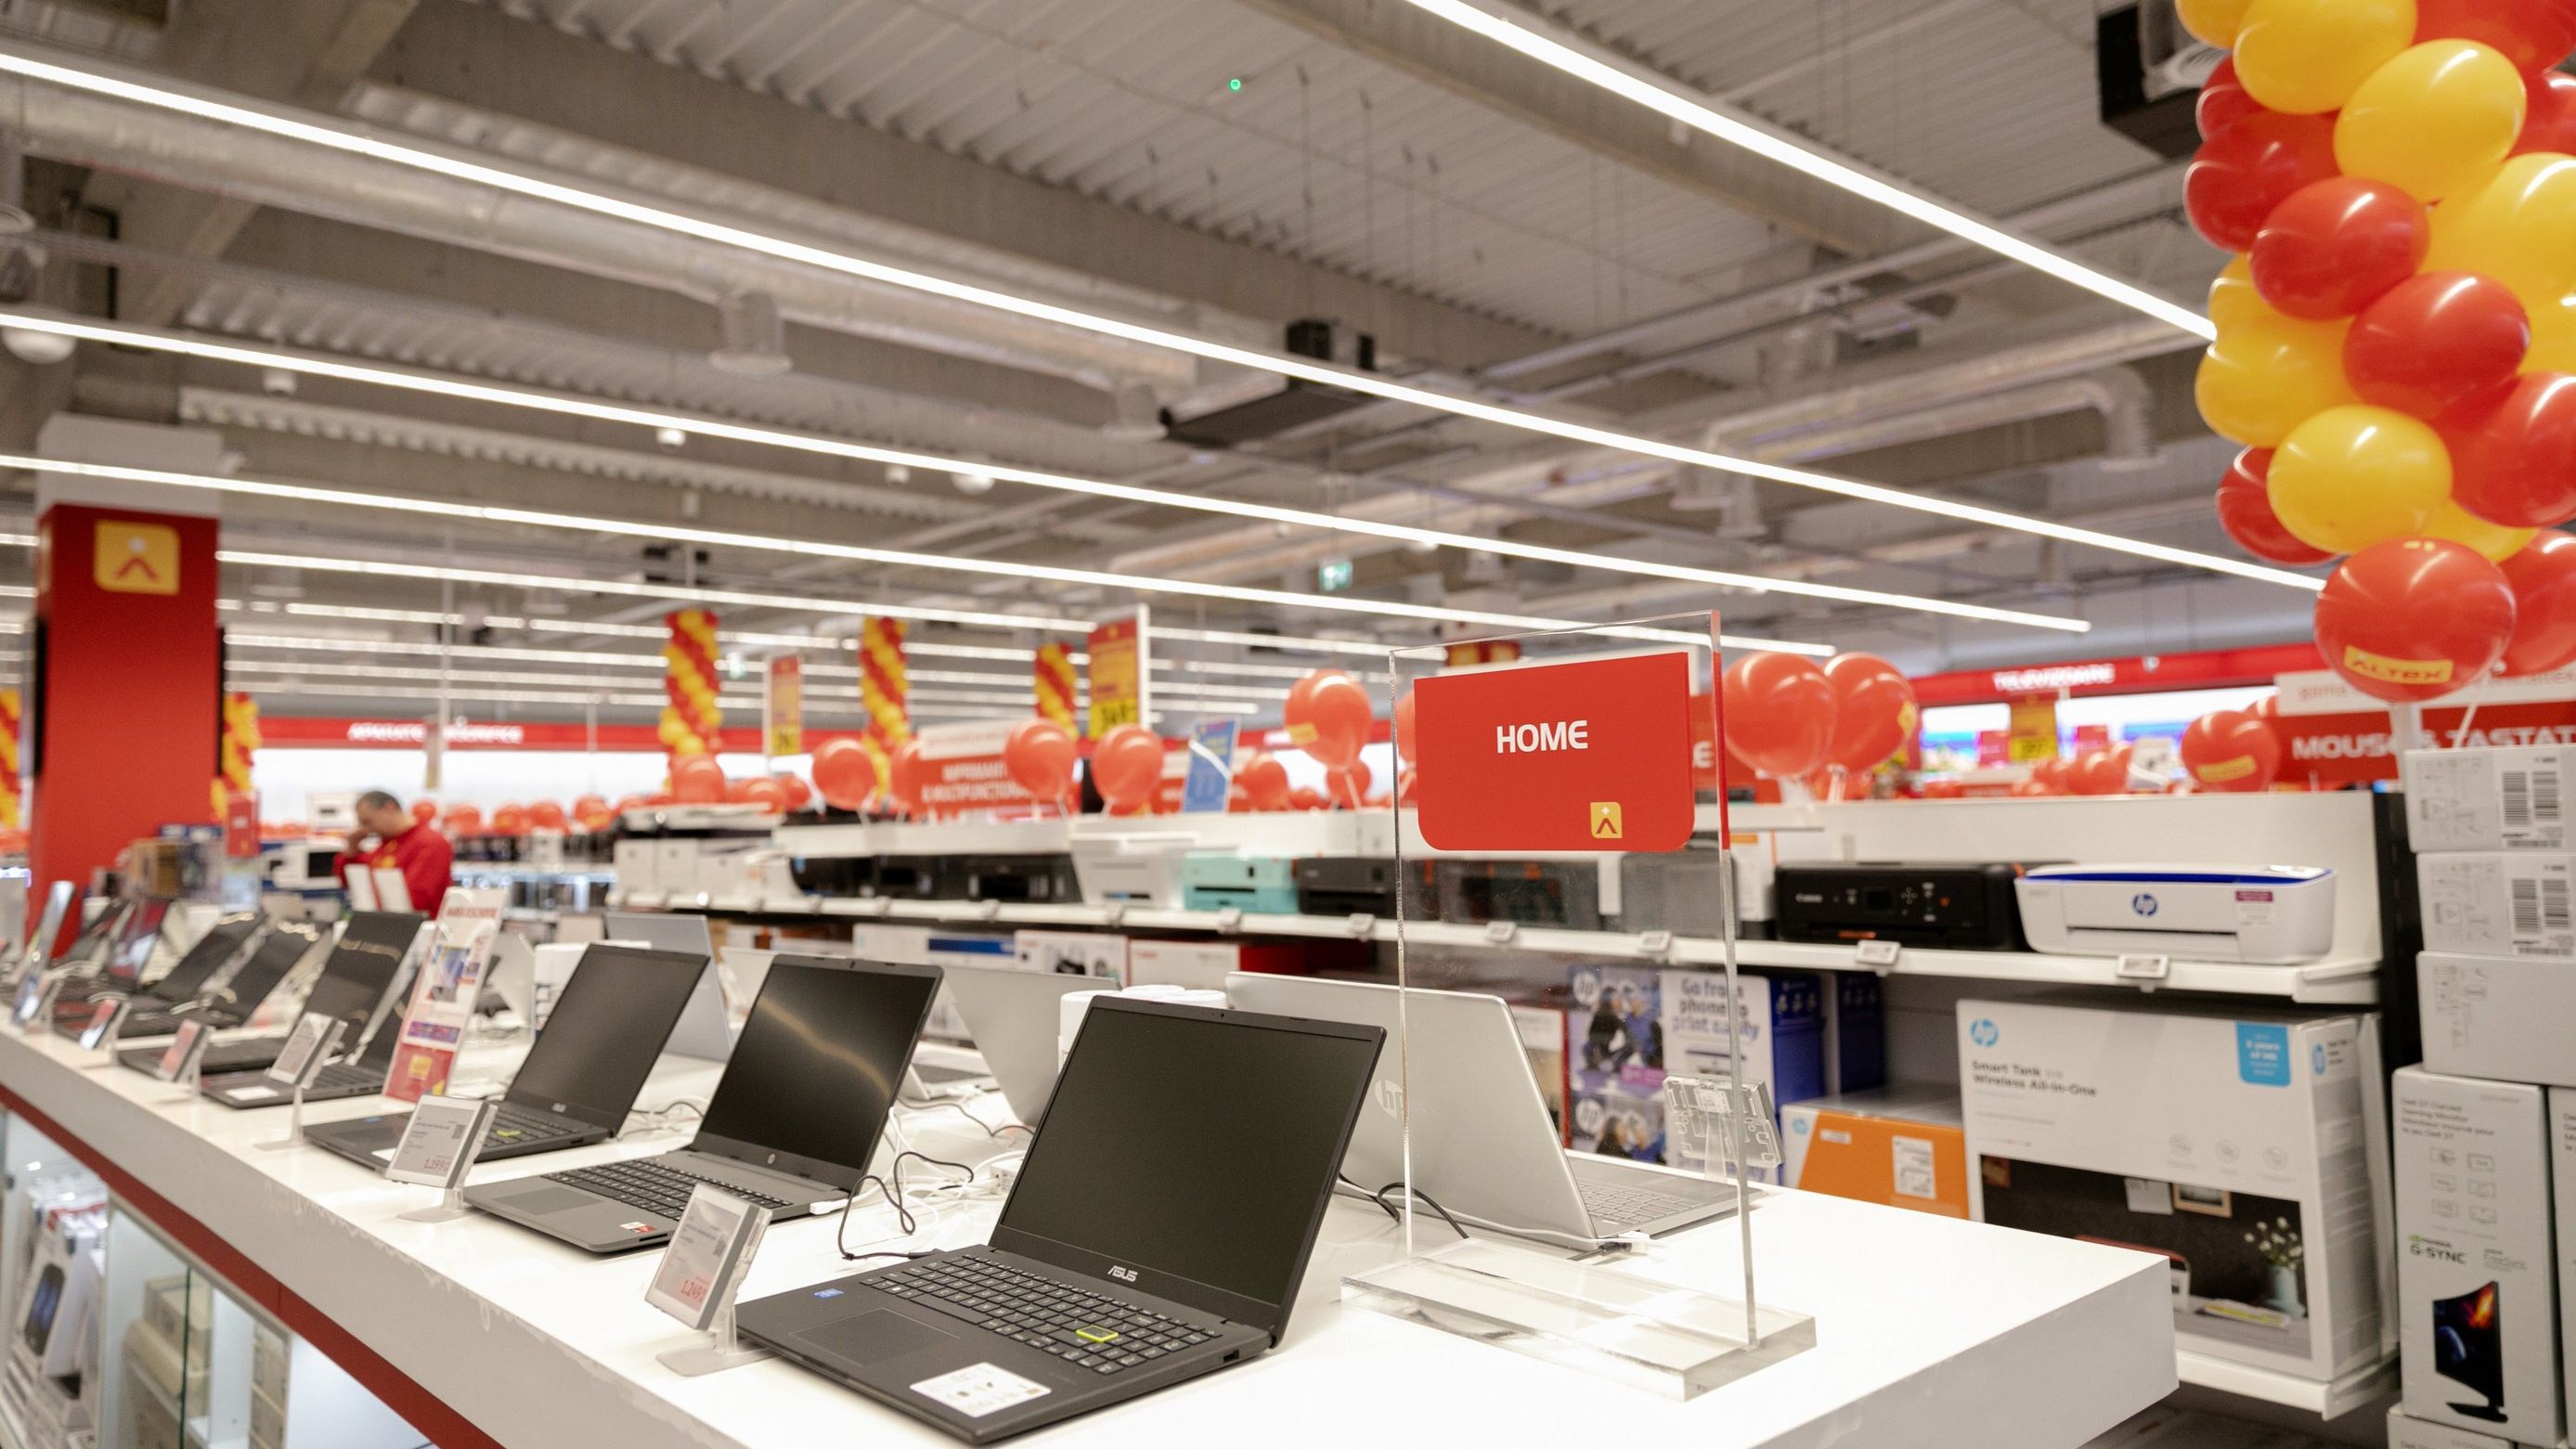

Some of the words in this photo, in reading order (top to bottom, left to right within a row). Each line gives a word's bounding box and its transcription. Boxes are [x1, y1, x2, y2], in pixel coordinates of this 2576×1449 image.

[1496, 719, 1588, 754] HOME
[2292, 731, 2393, 760] MOUS
[1970, 1017, 2000, 1048] hp
[1972, 1059, 2008, 1074] Smart
[2013, 1062, 2040, 1077] Tank
[1973, 1074, 2026, 1089] Wireless
[2029, 1080, 2097, 1097] All-in-One
[2410, 1243, 2467, 1265] G-SYNC
[1107, 1264, 1139, 1283] ASUS
